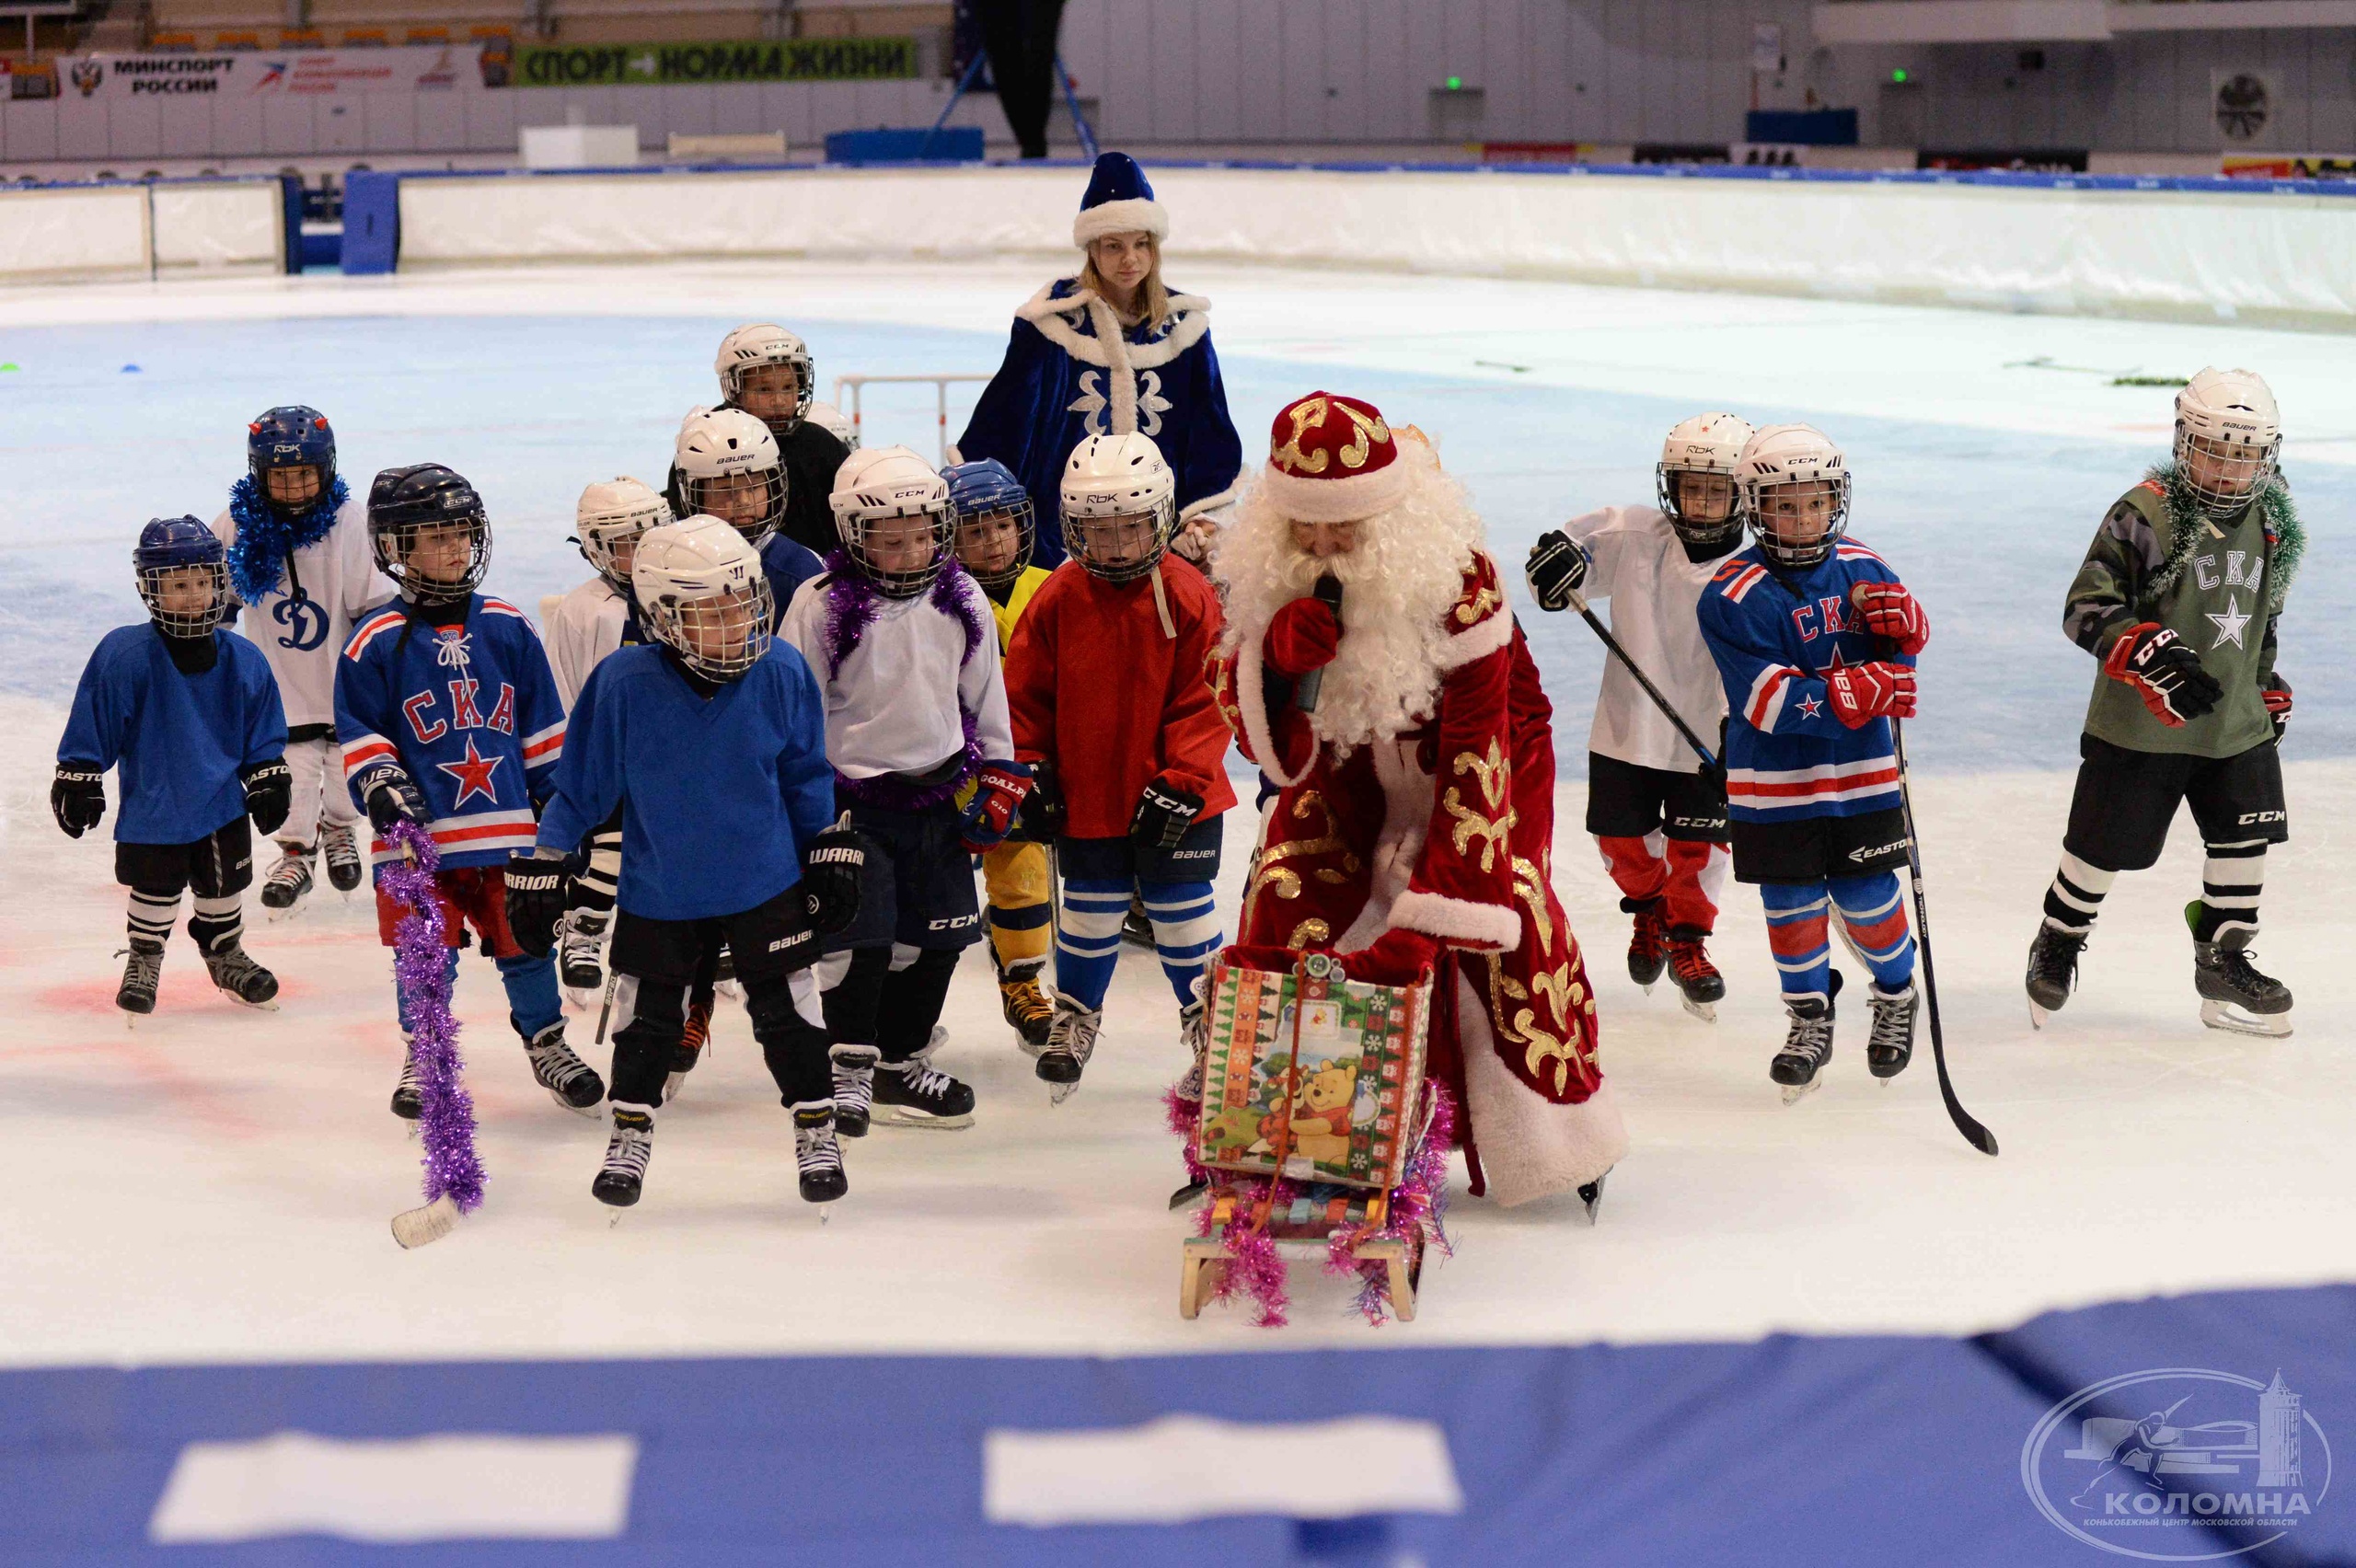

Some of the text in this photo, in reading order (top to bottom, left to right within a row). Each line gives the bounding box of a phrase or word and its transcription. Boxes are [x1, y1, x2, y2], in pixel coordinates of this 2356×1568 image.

[114, 59, 235, 75] МИНСПОРТ
[527, 45, 905, 81] СПОРТ НОРМА ЖИЗНИ
[132, 78, 218, 93] РОССИИ
[1788, 457, 1818, 466] CCM
[446, 498, 470, 506] CCM
[895, 490, 925, 499] CCM
[402, 678, 514, 744] СКА
[991, 800, 1008, 814] G10
[1143, 786, 1197, 817] CCM
[1674, 816, 1727, 828] CCM
[2237, 811, 2285, 825] CCM
[929, 913, 978, 930] CCM
[1918, 896, 1928, 939] TECHNOLOGY
